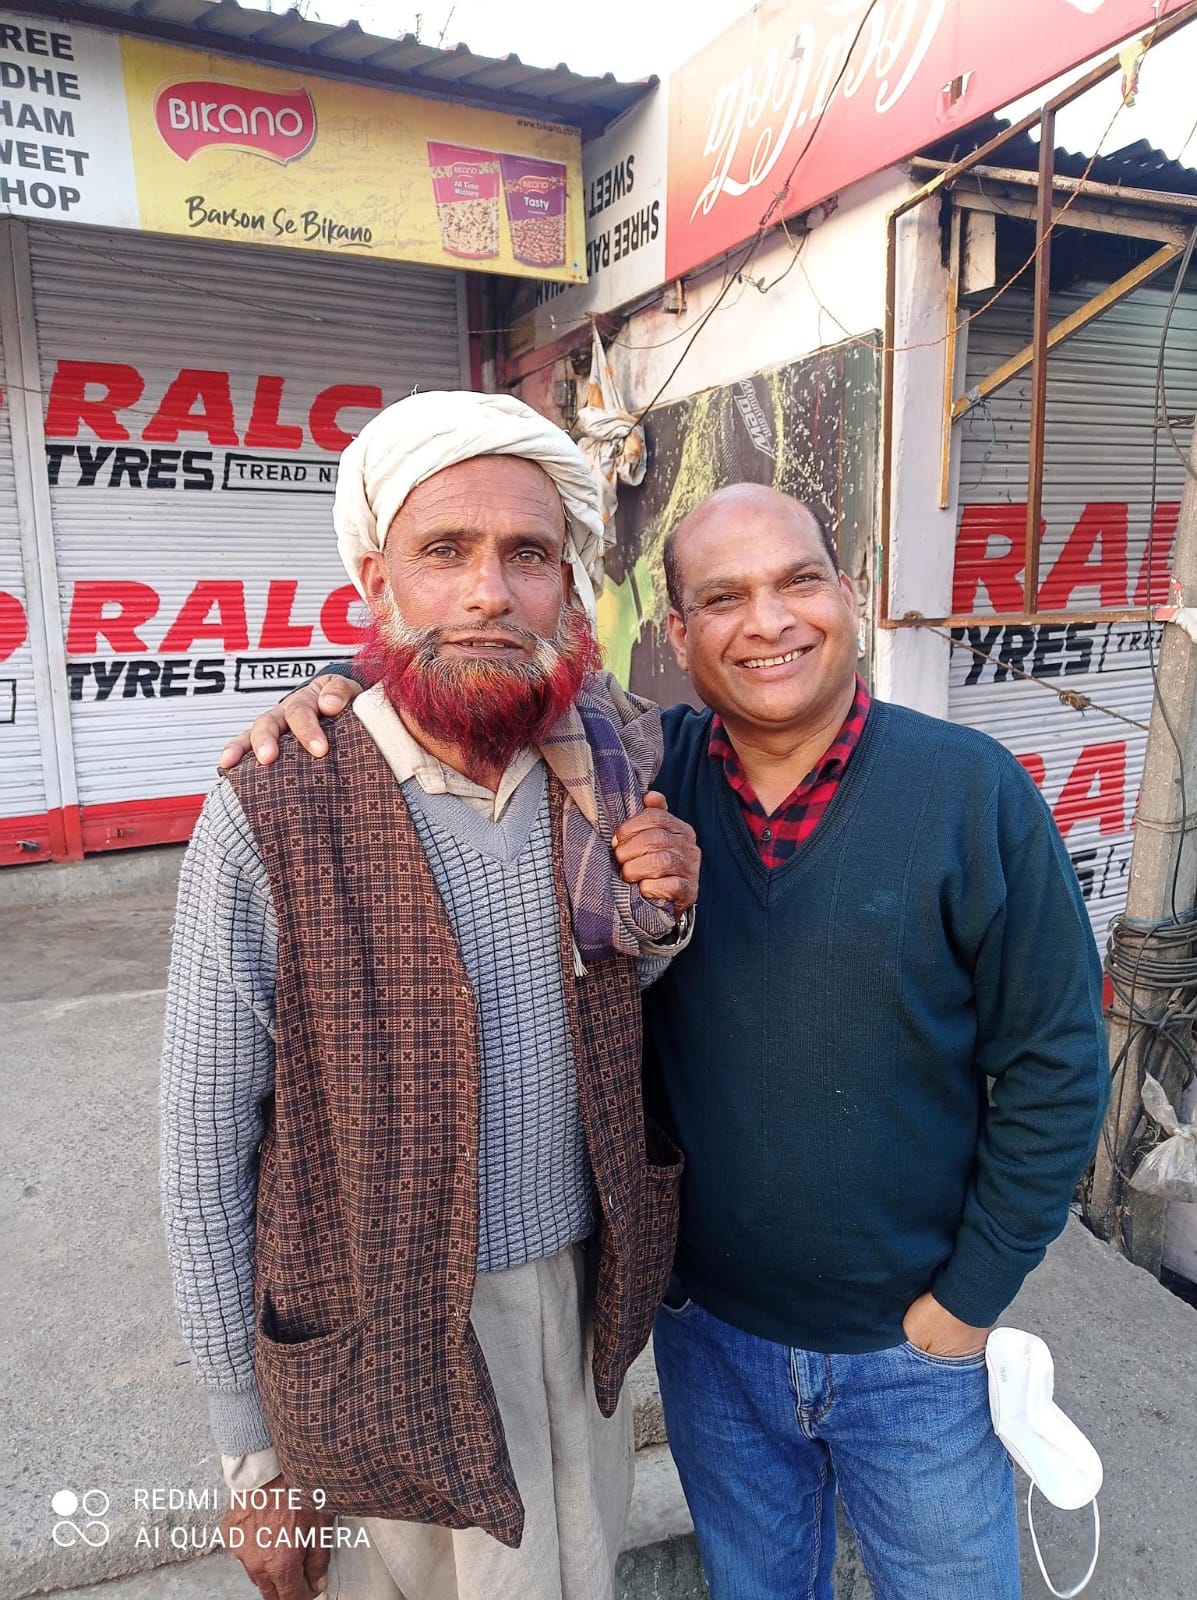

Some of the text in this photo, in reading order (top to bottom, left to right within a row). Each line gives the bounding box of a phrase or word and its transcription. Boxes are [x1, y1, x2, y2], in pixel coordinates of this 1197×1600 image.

[0, 61, 81, 100] DHE
[0, 177, 81, 212] HOP
[454, 187, 480, 197] Mixture
[464, 181, 479, 190] Time
[523, 196, 550, 211] Tasty
[588, 153, 635, 219] SWEET
[185, 195, 373, 245] Barson Se Bikano
[613, 199, 660, 262] SHREE
[44, 445, 214, 490] TYRES
[235, 463, 308, 481] TREAD
[67, 659, 317, 702] TYRES TREAD
